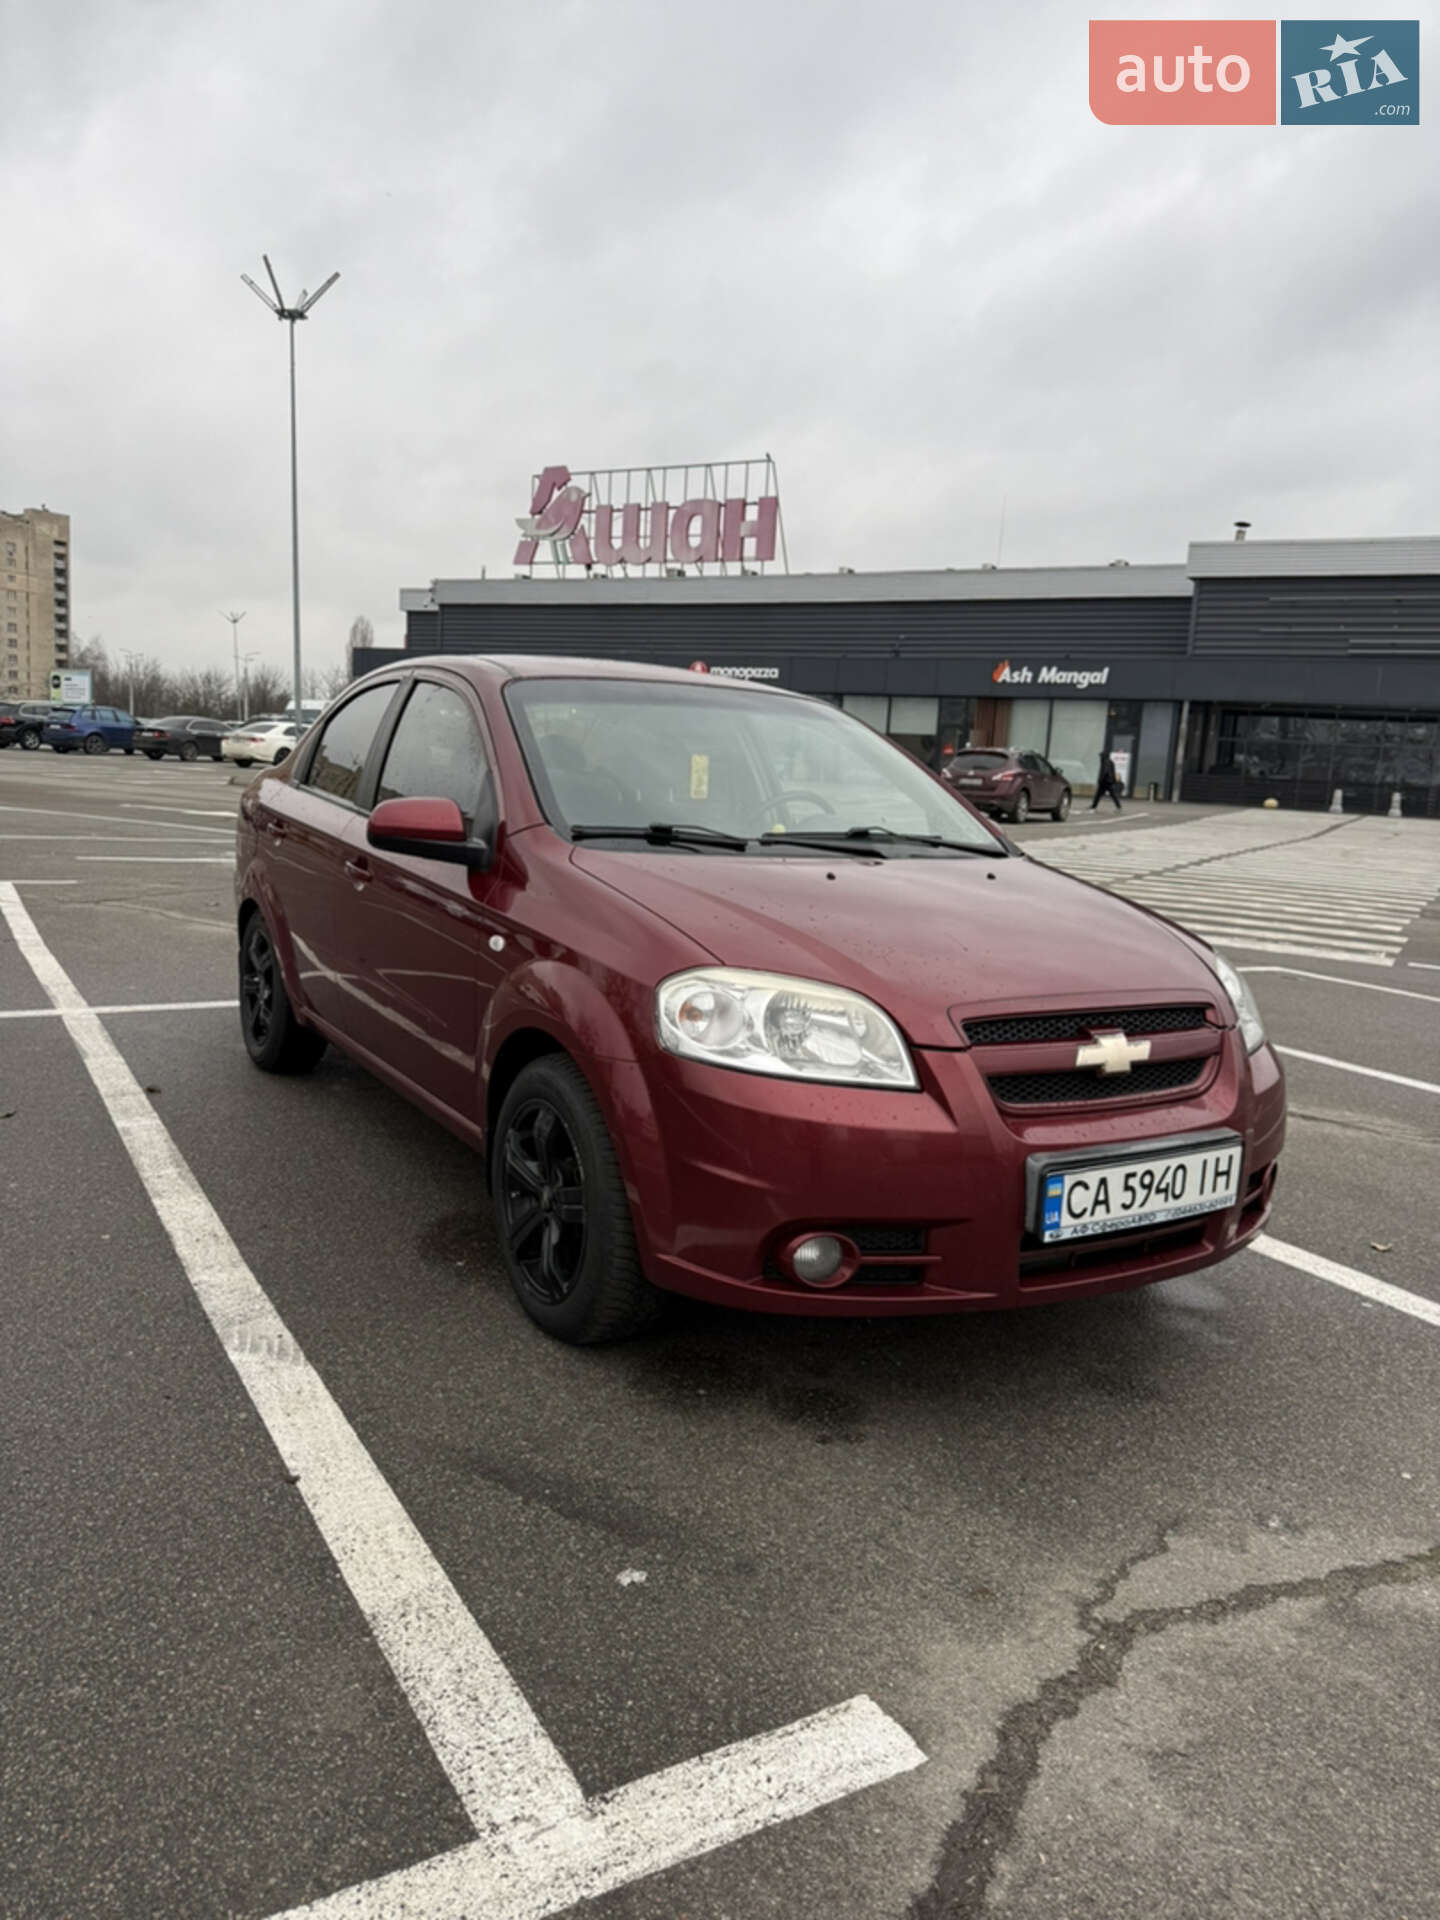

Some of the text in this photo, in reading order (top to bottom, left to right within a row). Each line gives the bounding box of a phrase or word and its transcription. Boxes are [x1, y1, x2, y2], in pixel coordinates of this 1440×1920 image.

[997, 665, 1110, 689] Ash Mangal
[1066, 1176, 1111, 1219] CA
[1121, 1163, 1187, 1211] 5940
[1199, 1154, 1234, 1196] IH
